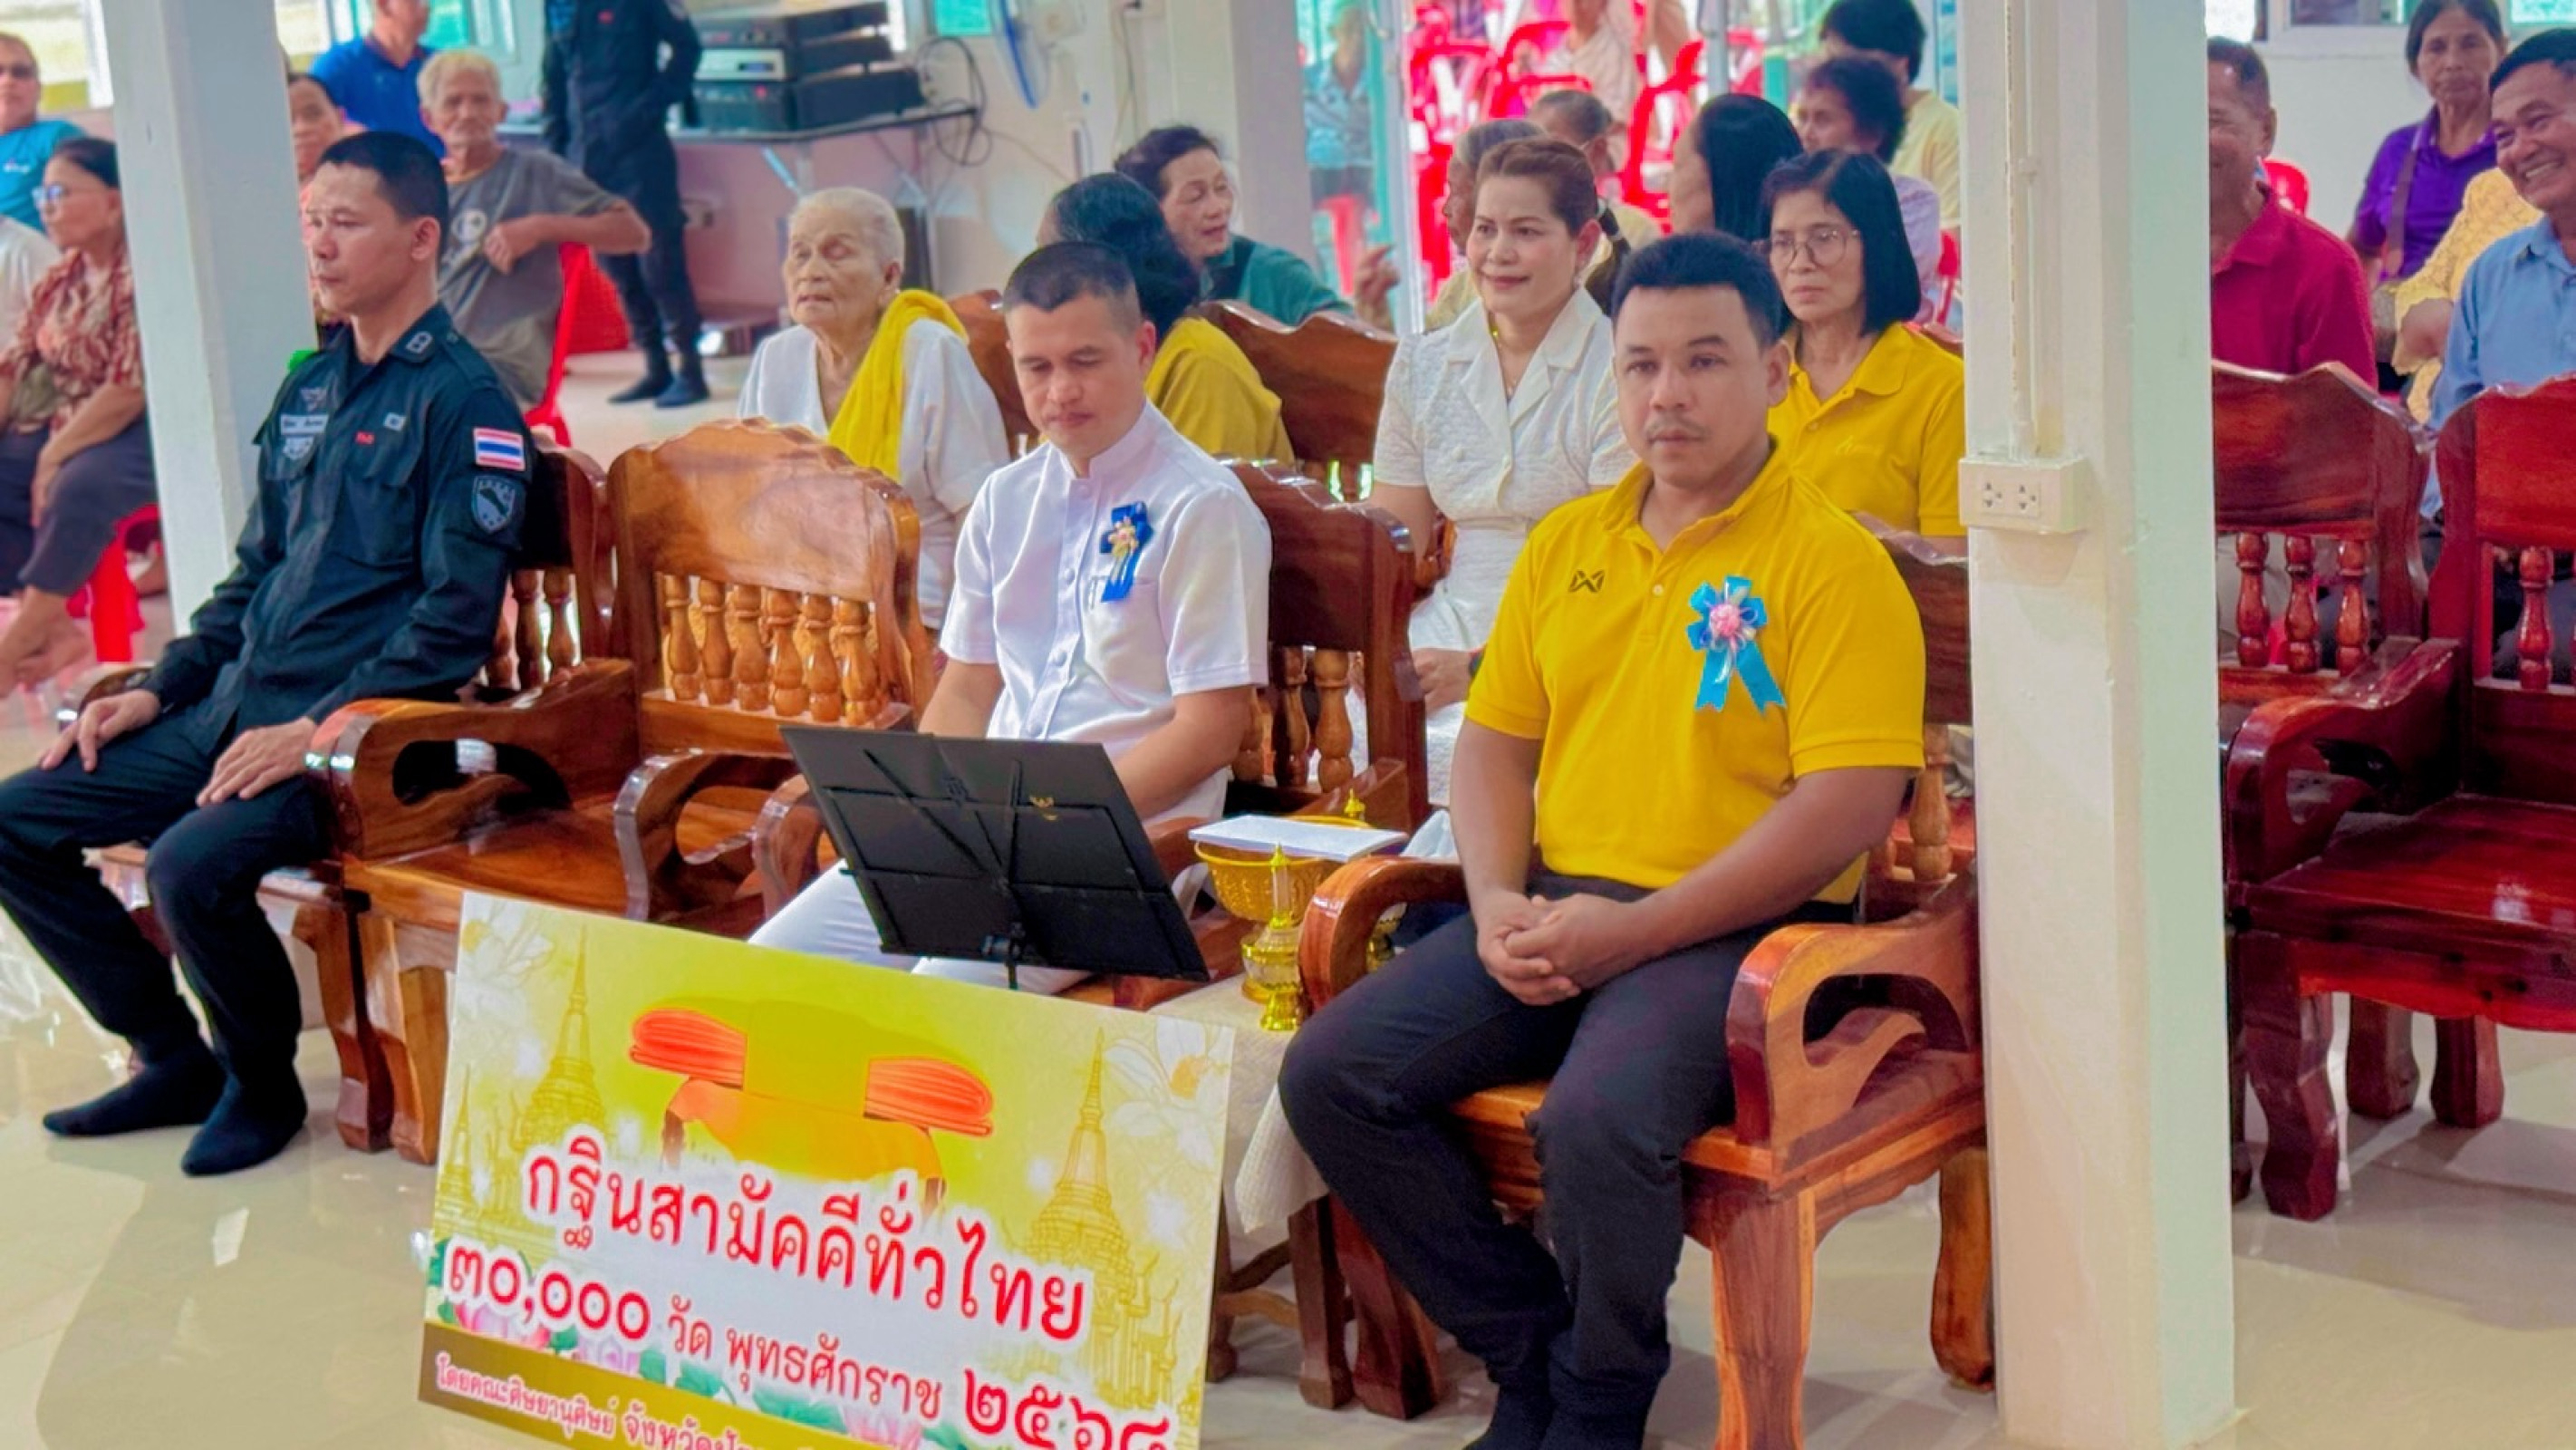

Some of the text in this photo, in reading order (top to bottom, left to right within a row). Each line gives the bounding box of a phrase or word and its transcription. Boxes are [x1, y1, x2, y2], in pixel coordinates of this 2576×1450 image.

[449, 1245, 651, 1341] ๓๐,๐๐๐
[667, 1294, 712, 1359] วัด
[726, 1328, 942, 1420] พุทธศักราช
[529, 1136, 1084, 1340] กฐินสามัคคีทั่วไทย
